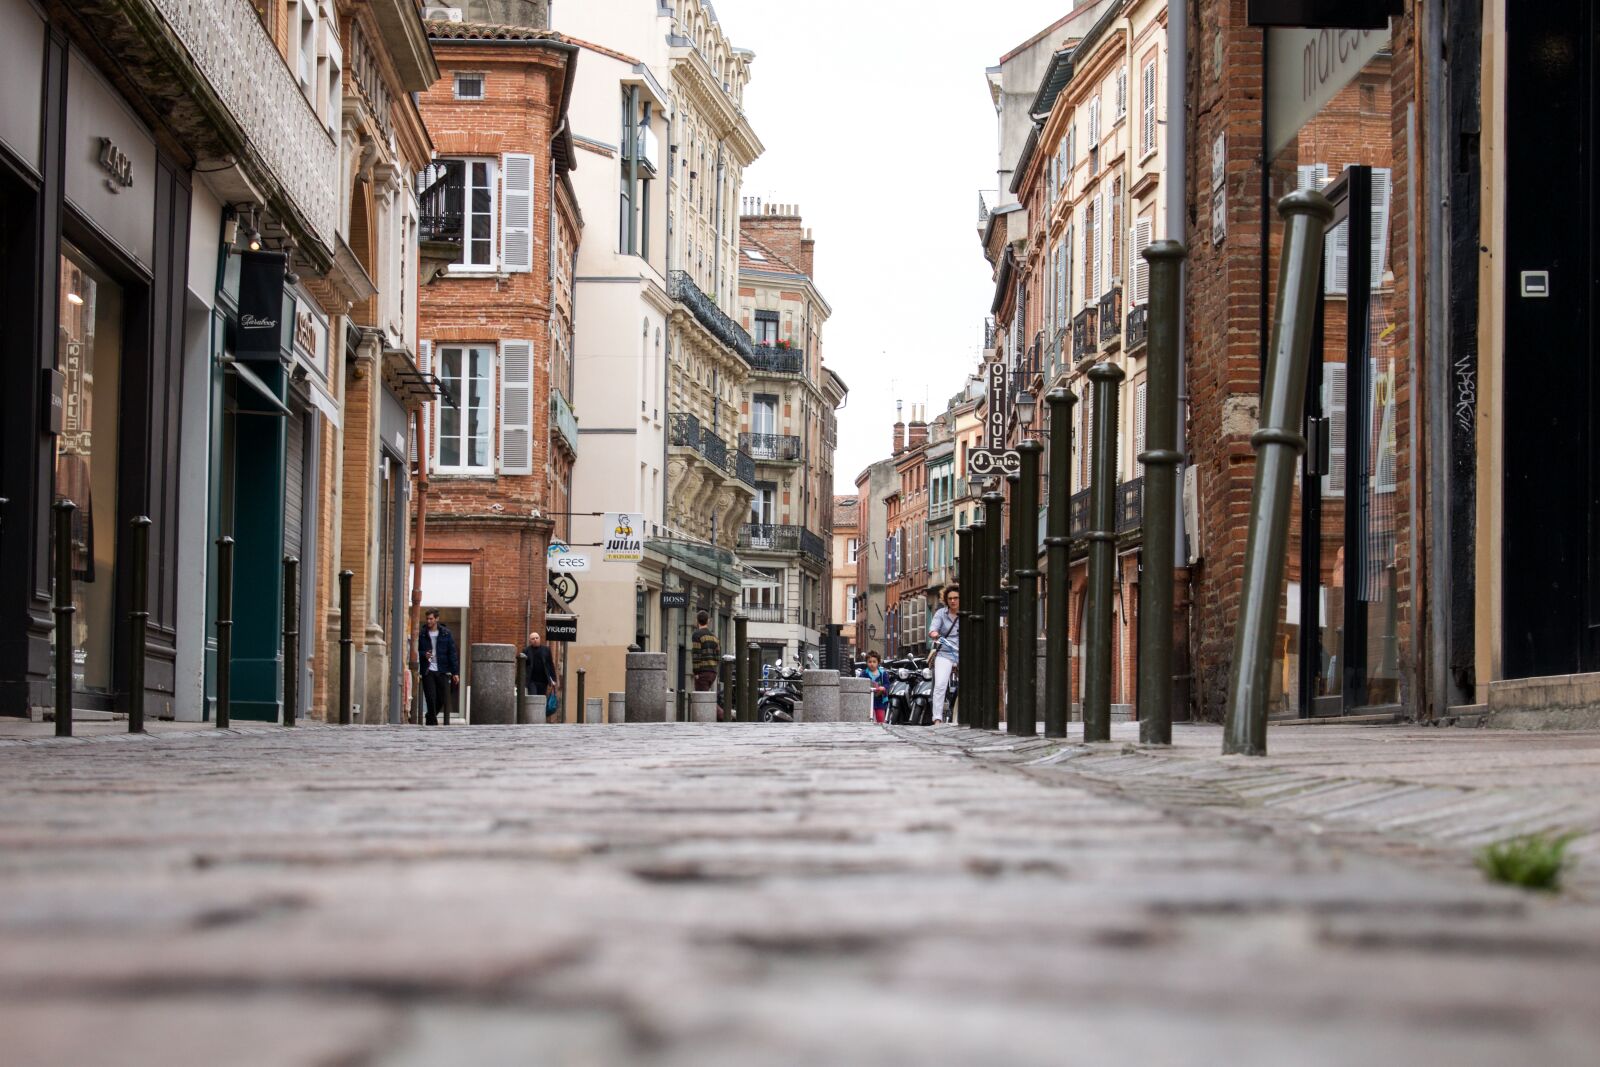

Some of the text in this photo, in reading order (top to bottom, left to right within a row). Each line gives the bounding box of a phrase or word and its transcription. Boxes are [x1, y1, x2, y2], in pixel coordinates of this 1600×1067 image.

[97, 136, 133, 186] ZAPA
[992, 363, 1003, 449] OPTIQUE
[606, 540, 640, 550] JUILIA
[558, 558, 585, 567] ERES
